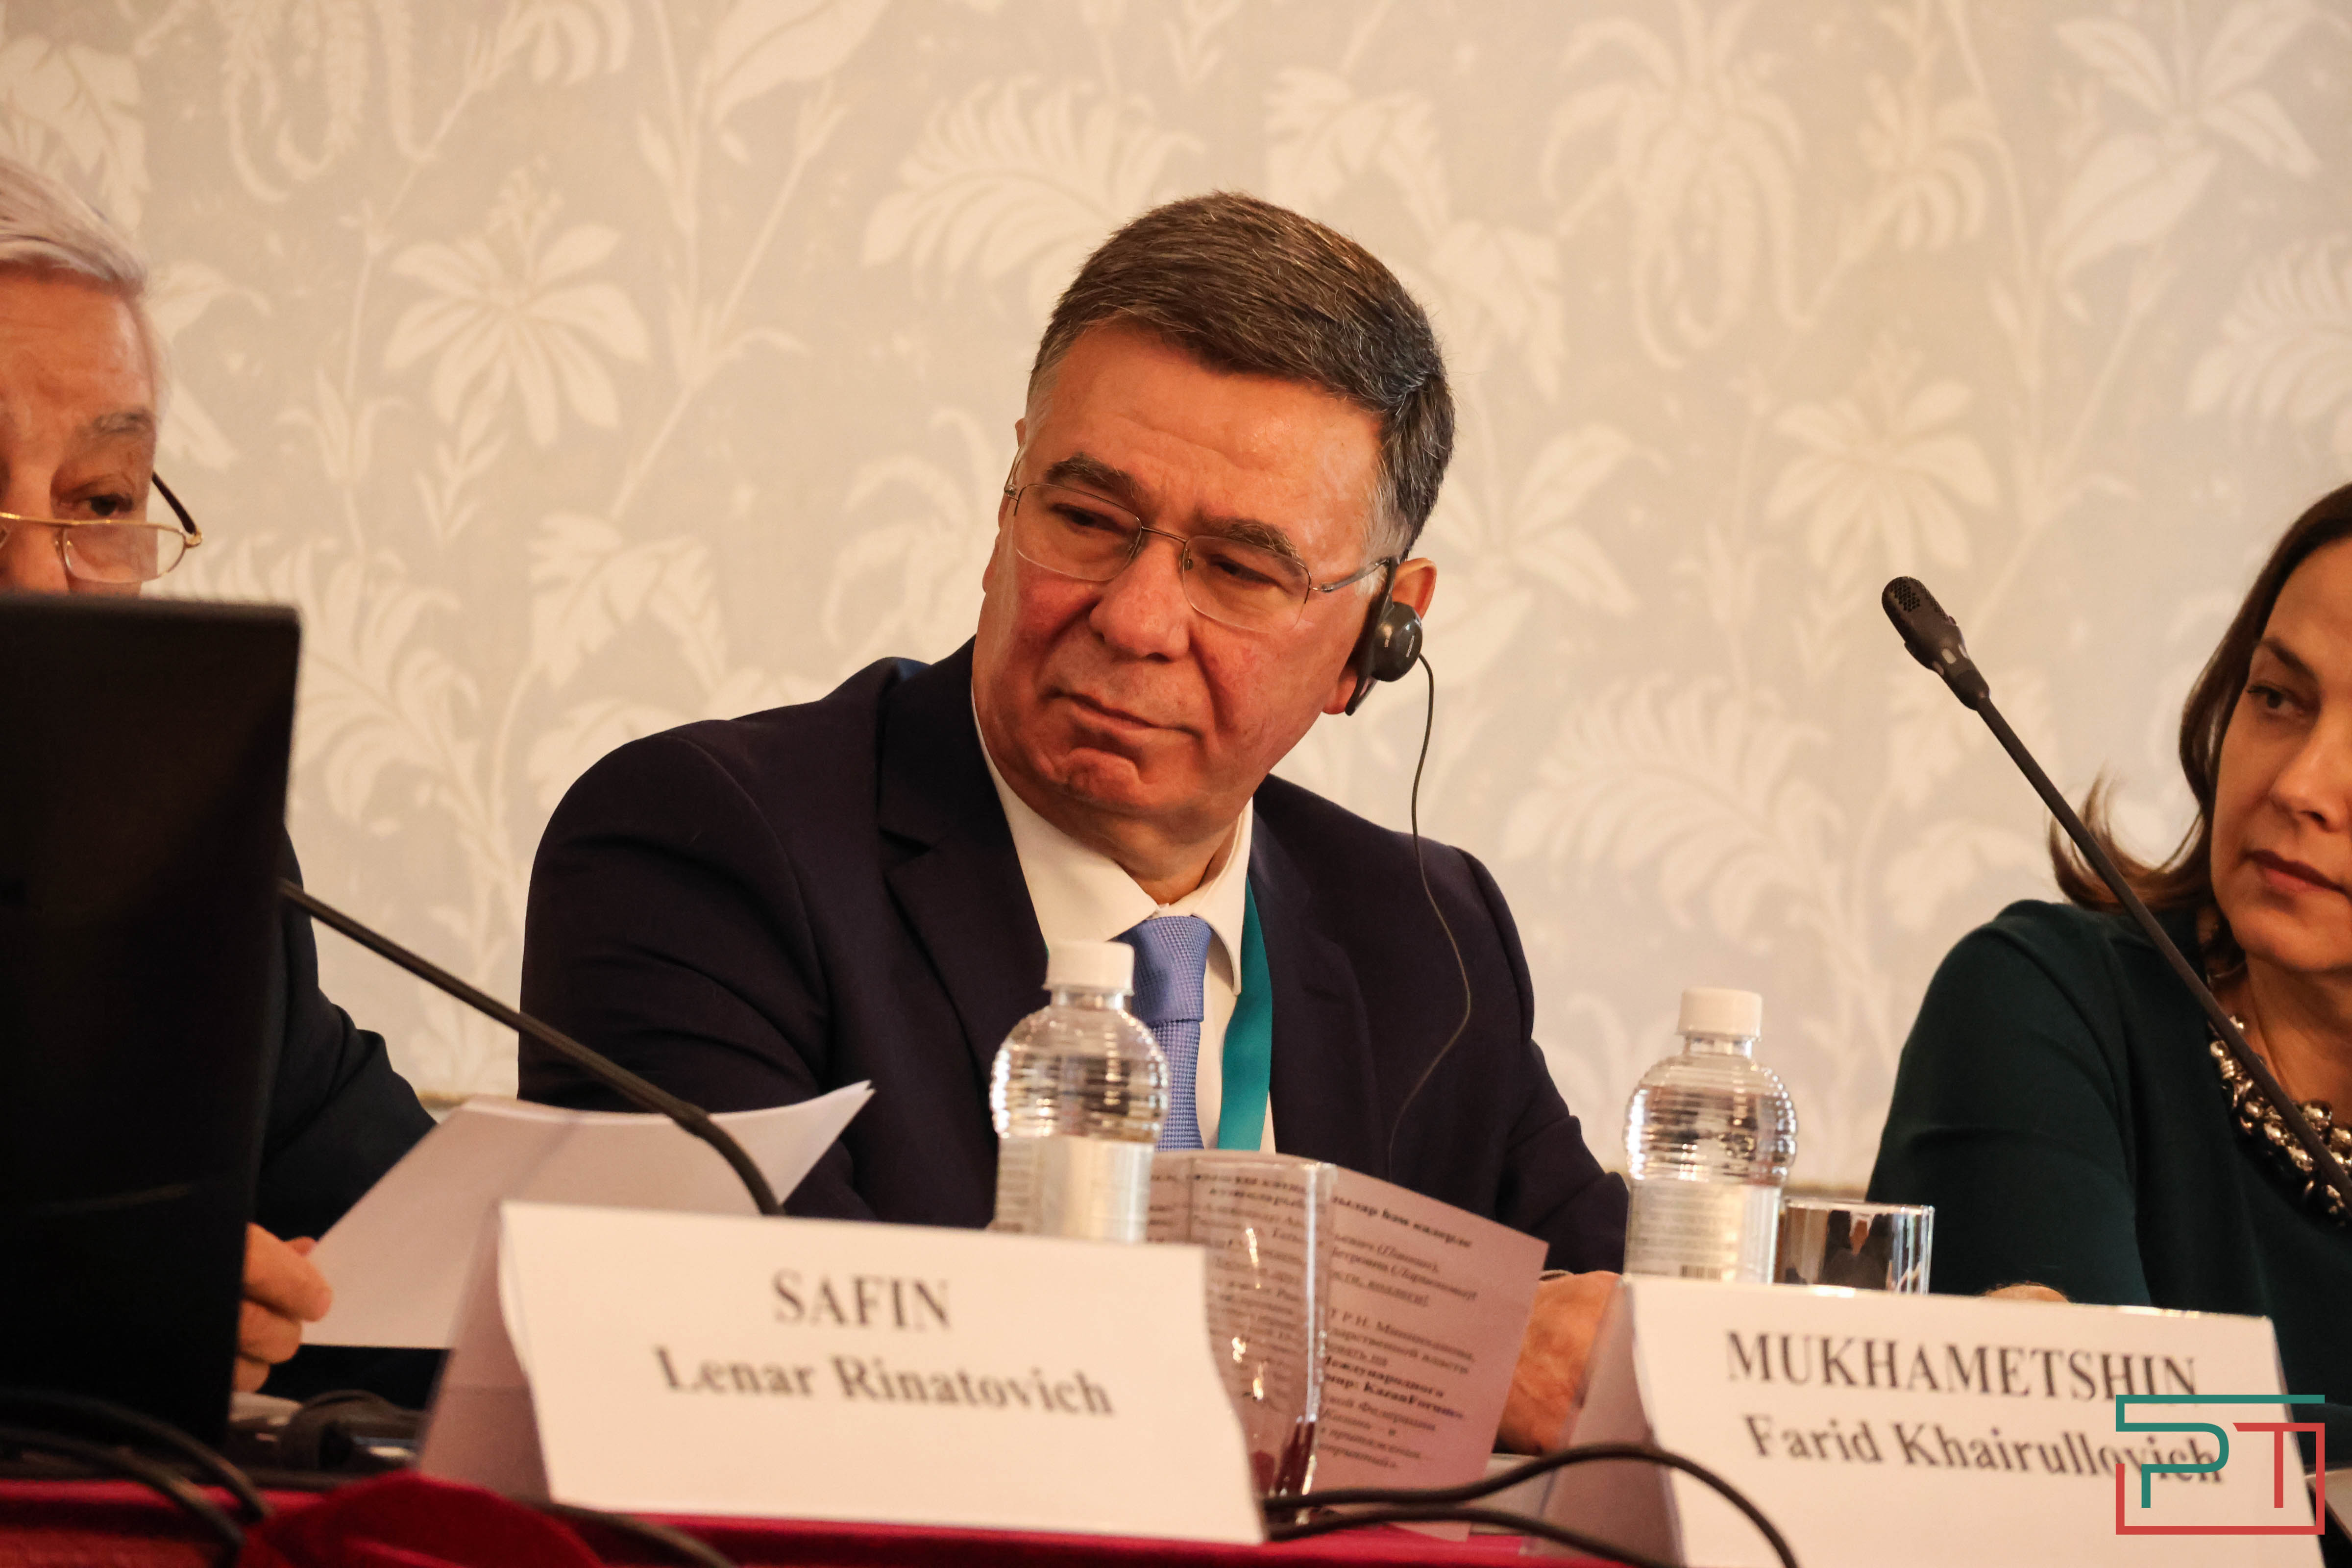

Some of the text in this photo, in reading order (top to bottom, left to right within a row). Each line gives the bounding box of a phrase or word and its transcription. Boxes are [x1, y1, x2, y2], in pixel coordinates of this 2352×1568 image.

[771, 1268, 951, 1330] SAFIN
[654, 1346, 1115, 1416] Lenar Rinatovich
[1726, 1330, 2198, 1405] MUKHAMETSHIN
[1742, 1412, 2222, 1483] Farid Khairullovich
